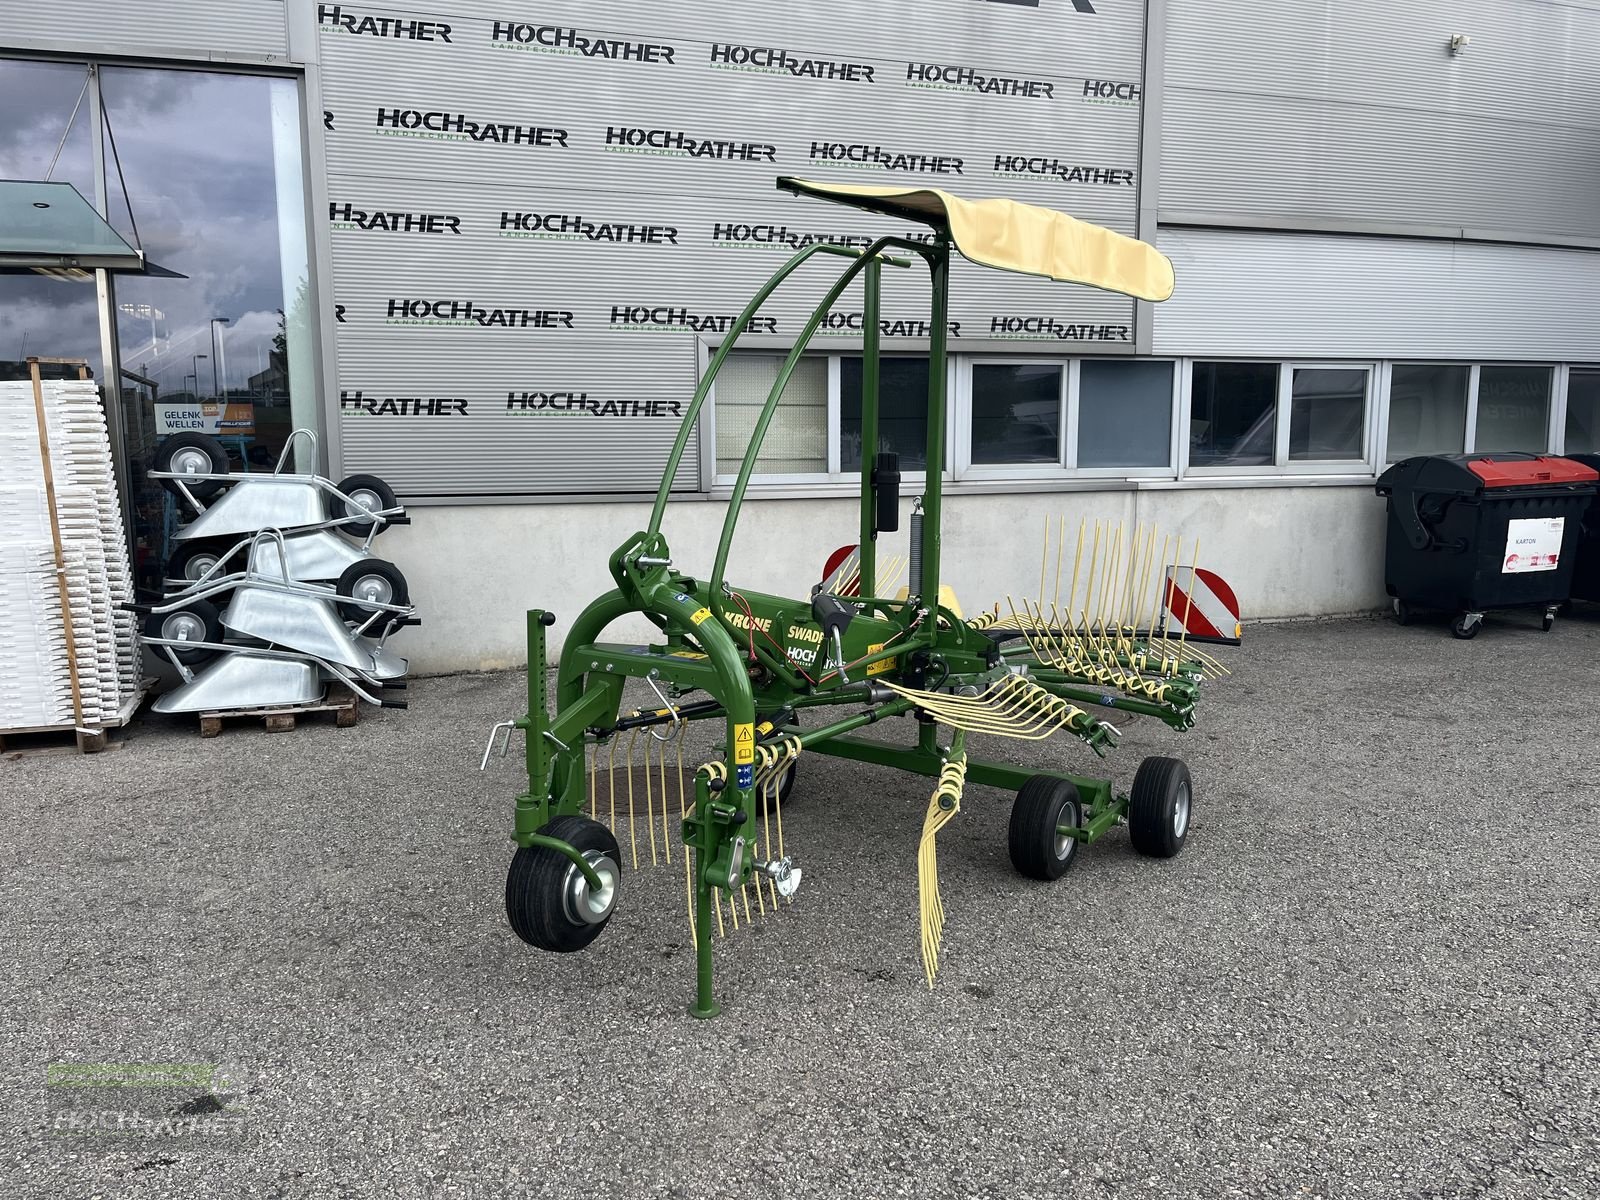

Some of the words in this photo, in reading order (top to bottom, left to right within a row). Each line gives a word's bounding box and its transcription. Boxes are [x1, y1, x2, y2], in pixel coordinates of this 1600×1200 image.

[491, 43, 579, 56] LANDTECHNIK
[493, 22, 675, 64] HOCHRATHER
[709, 63, 789, 75] LANDTECHNIK
[711, 44, 875, 83] HOCHRATHER
[907, 63, 1054, 99] HOCHRATHER
[375, 129, 468, 141] LANDTECHNIK
[376, 108, 569, 148] HOCHRATHER
[604, 145, 688, 157] LANDTECHNIK
[606, 126, 776, 162] HOCHRATHER
[809, 142, 964, 175] HOCHRATHER
[995, 155, 1134, 186] HOCHRATHER
[499, 231, 585, 241] LANDTECHNIK
[500, 212, 678, 244] HOCHRATHER
[386, 319, 477, 327] LANDTECHNIK
[387, 299, 574, 328] HOCHRATHER
[990, 316, 1128, 340] HOCHRATHER
[165, 411, 200, 419] GELENK
[506, 392, 681, 417] HOCHRATHER
[724, 611, 772, 633] KRONE
